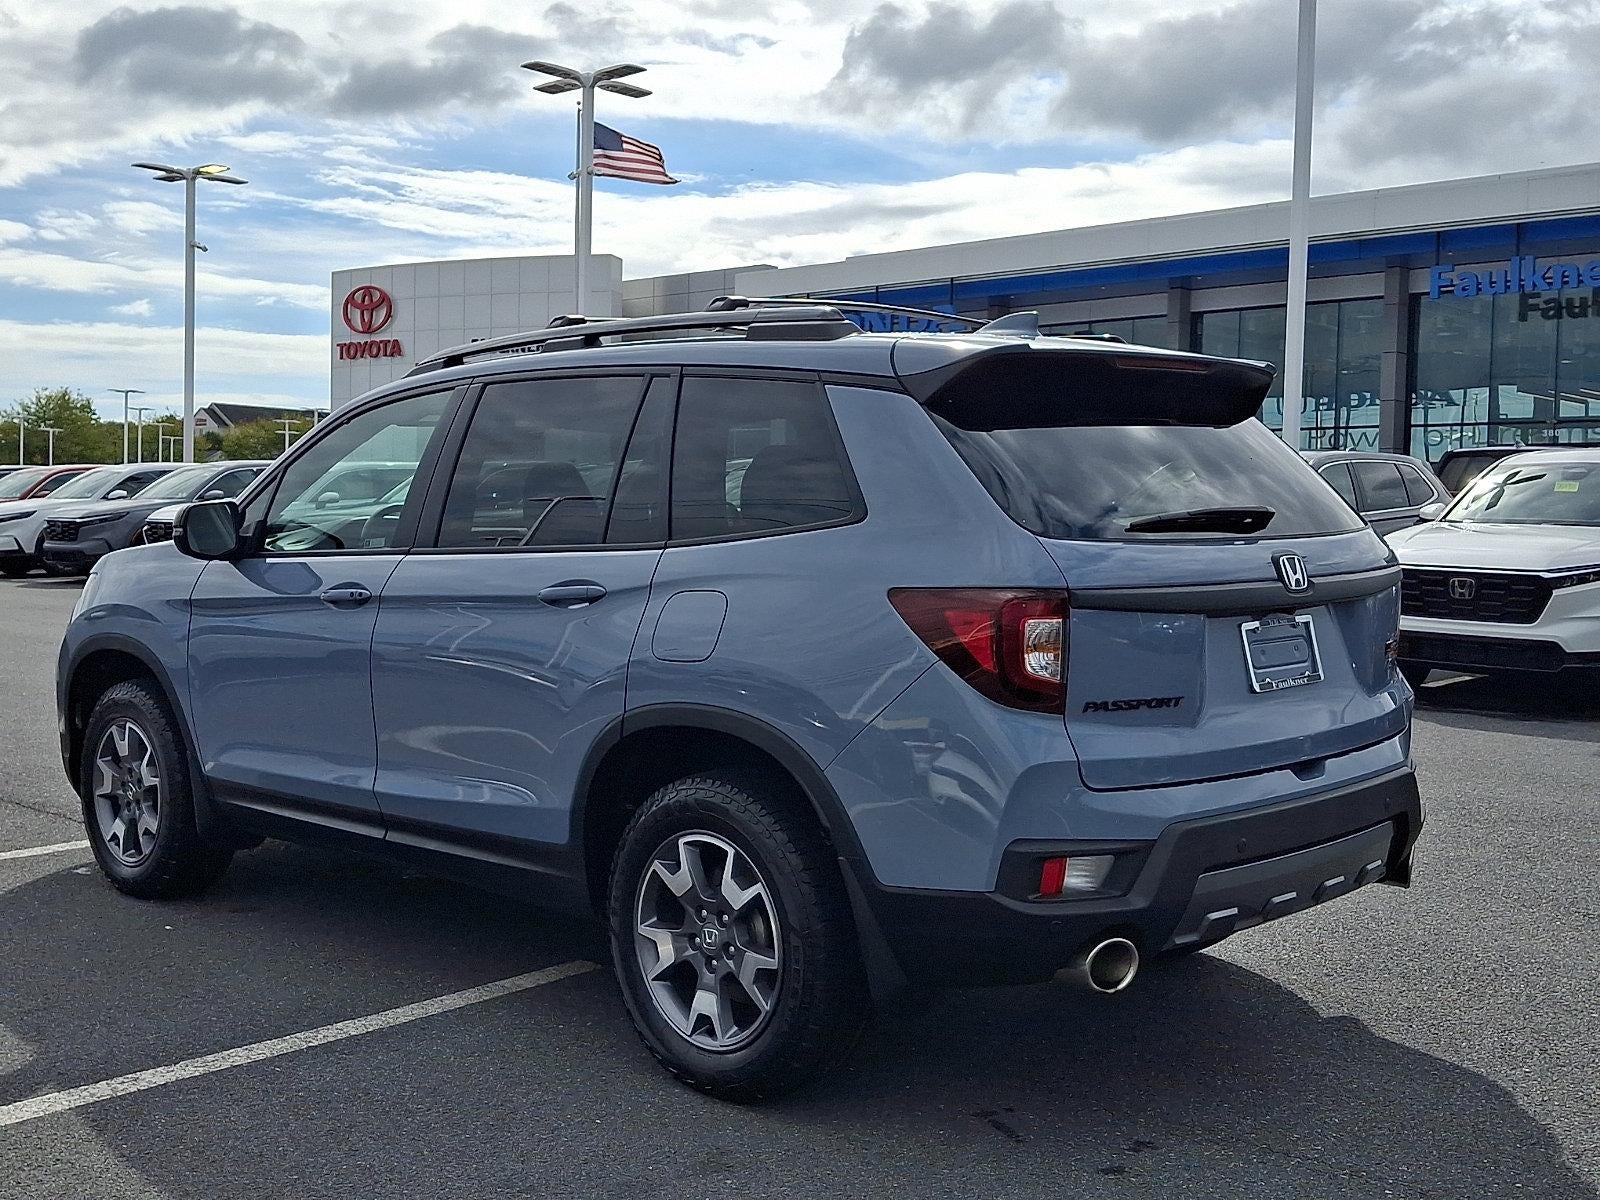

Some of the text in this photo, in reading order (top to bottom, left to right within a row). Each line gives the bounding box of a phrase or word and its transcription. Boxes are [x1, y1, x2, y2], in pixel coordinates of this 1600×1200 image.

[336, 338, 404, 360] TOYOTA
[1272, 677, 1309, 690] Faulkner
[1082, 696, 1184, 713] PASSPORT
